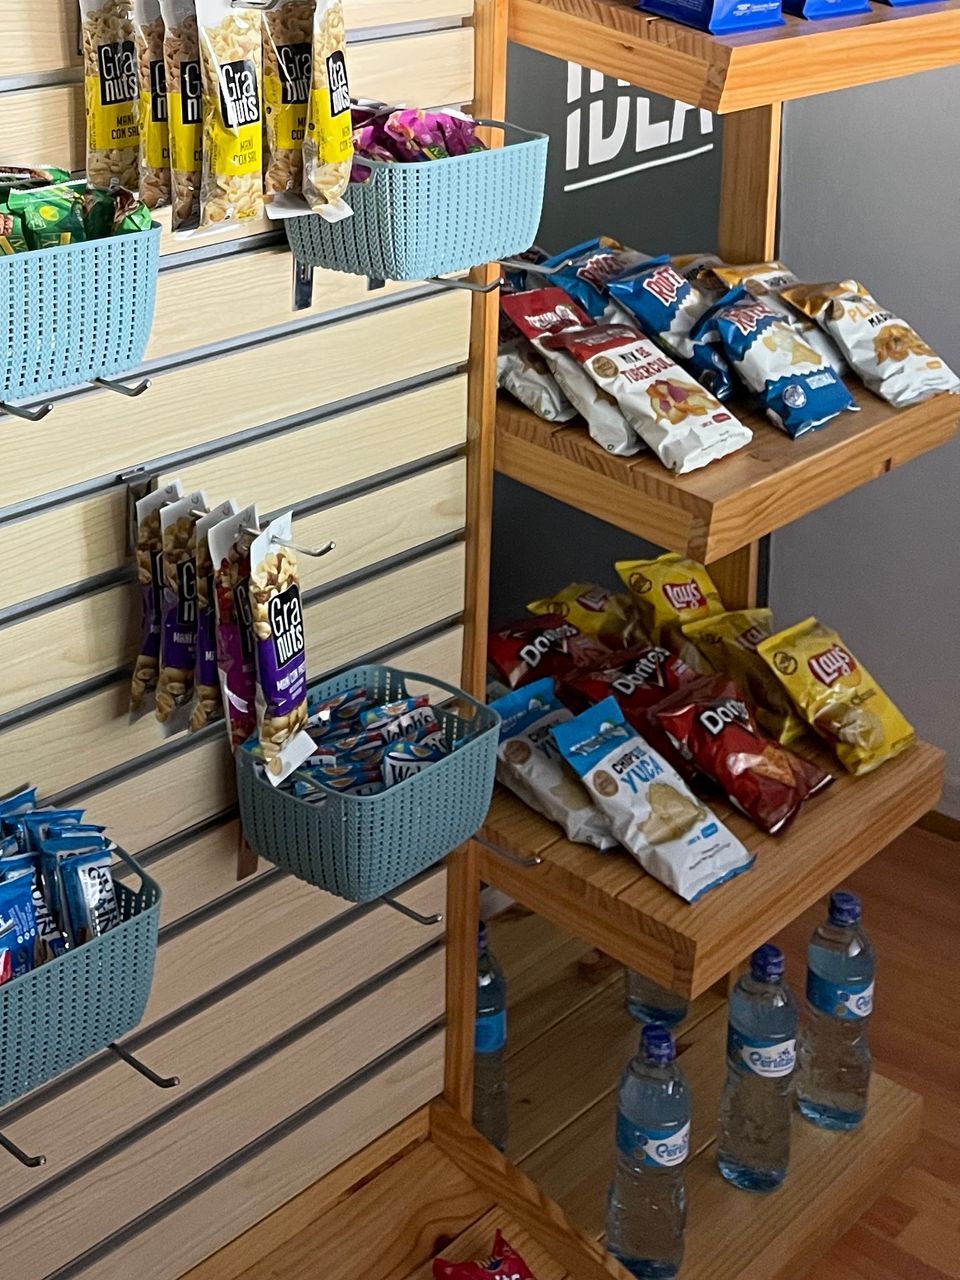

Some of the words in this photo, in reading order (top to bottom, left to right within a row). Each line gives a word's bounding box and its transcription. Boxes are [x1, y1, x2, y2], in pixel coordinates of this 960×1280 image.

[101, 46, 135, 79] Gra
[105, 74, 139, 102] nuts
[221, 64, 255, 101] Gra
[287, 76, 310, 102] nut
[227, 96, 259, 126] nuts
[111, 127, 126, 140] CON
[664, 581, 702, 610] Lay's
[270, 597, 301, 637] Gra
[276, 623, 304, 664] nuts
[613, 646, 671, 695] Doritos
[810, 645, 851, 685] Lay's
[621, 756, 665, 795] YUCA
